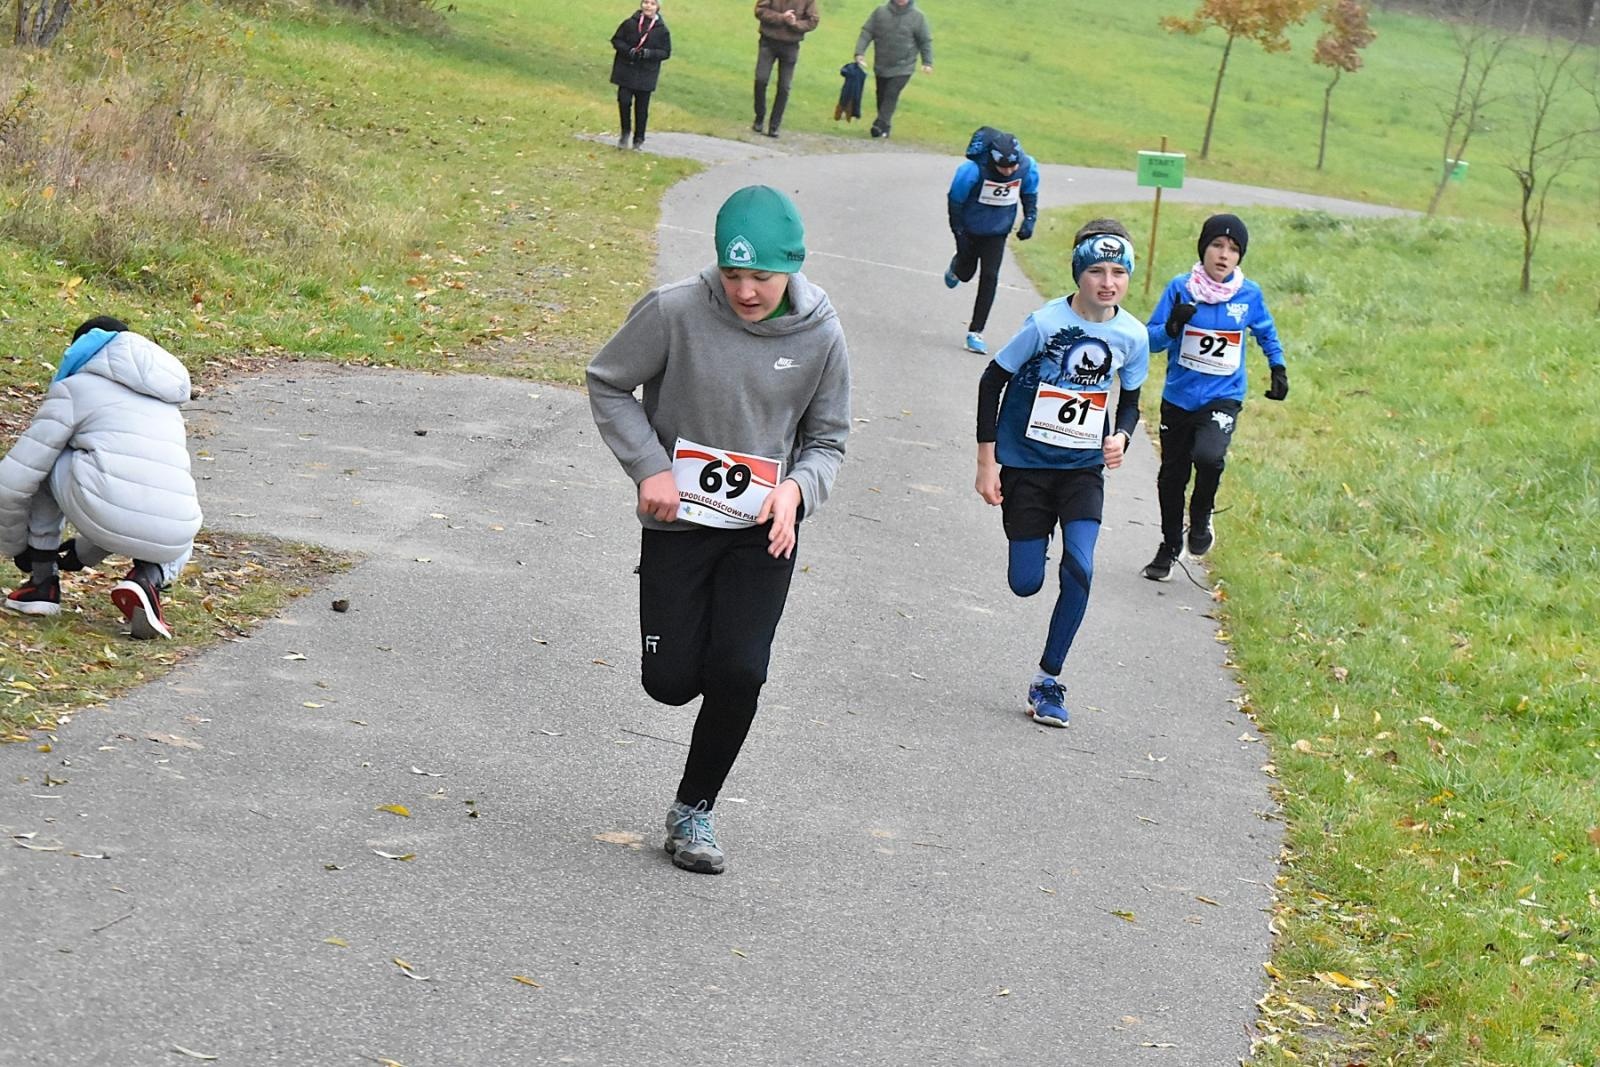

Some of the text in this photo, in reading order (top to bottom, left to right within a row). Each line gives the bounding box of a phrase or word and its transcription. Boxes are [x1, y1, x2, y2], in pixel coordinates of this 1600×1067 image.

[1199, 335, 1228, 357] 92
[1058, 397, 1092, 425] 61
[699, 459, 753, 500] 69
[678, 490, 743, 518] IEPODLEGŁOŚCIOWA
